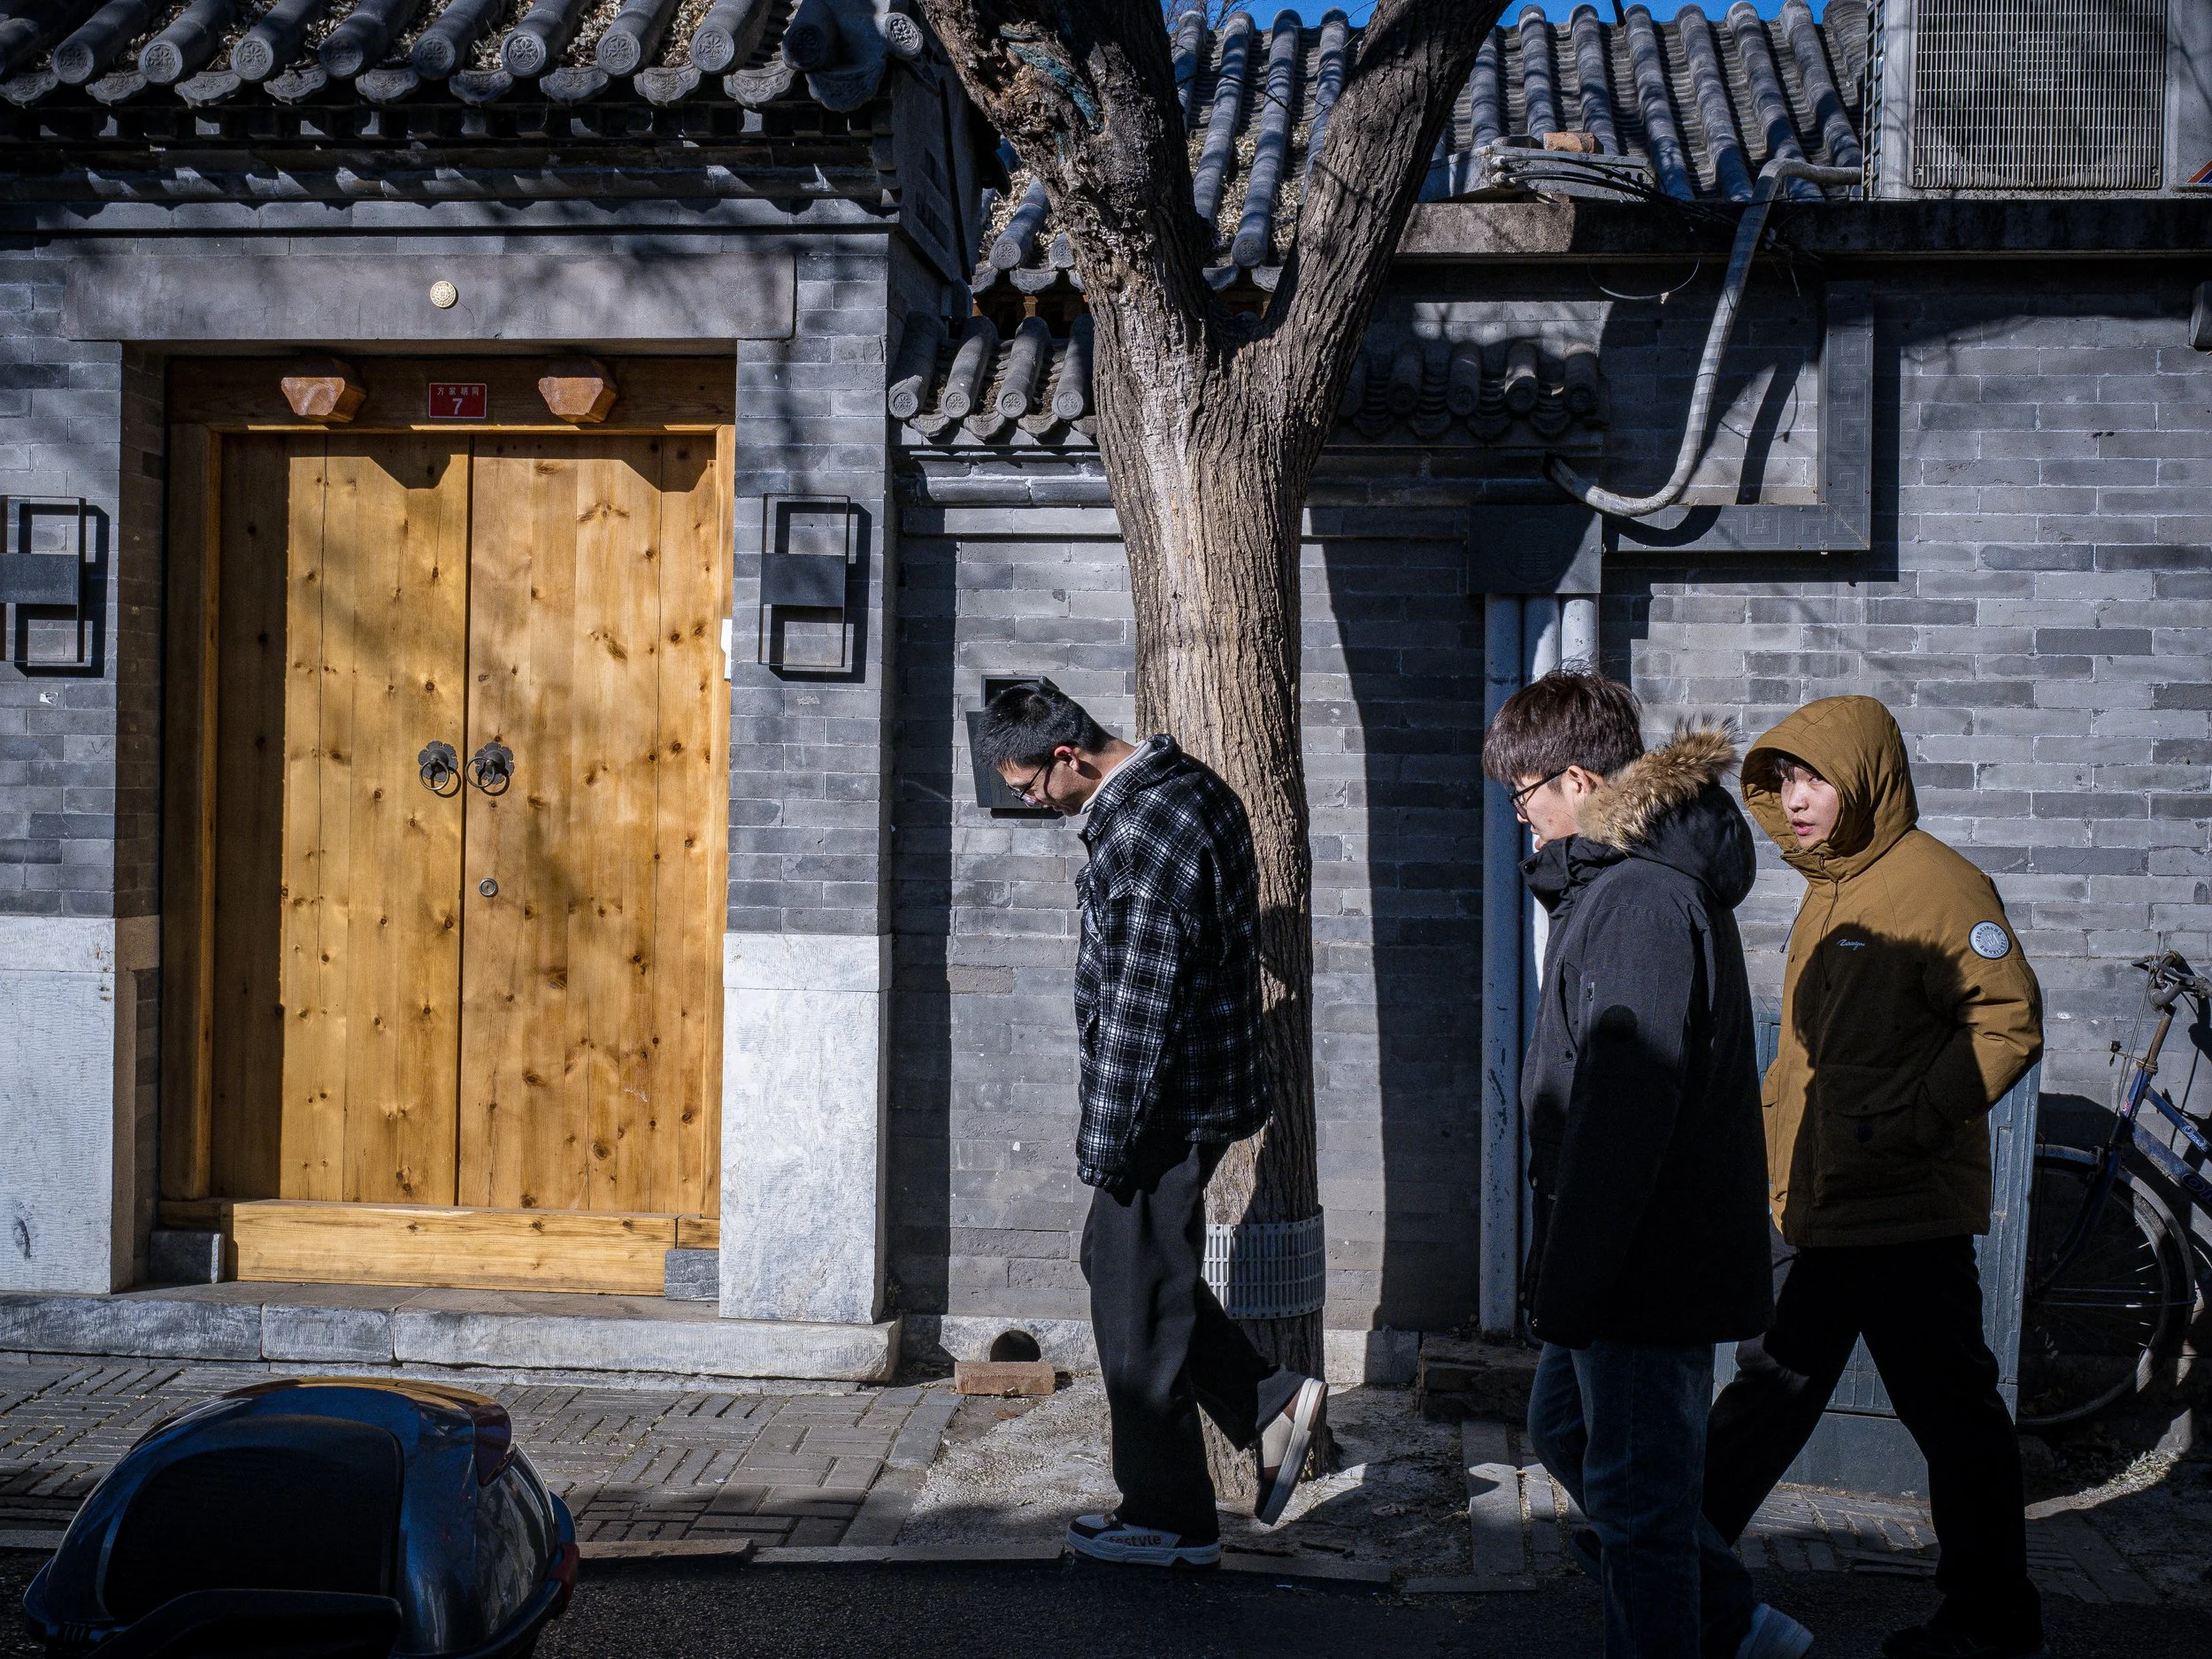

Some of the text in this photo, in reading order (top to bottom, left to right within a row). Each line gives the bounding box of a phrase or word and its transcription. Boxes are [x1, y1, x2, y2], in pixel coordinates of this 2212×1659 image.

[437, 387, 480, 396] 方家胡同
[452, 397, 464, 415] 7
